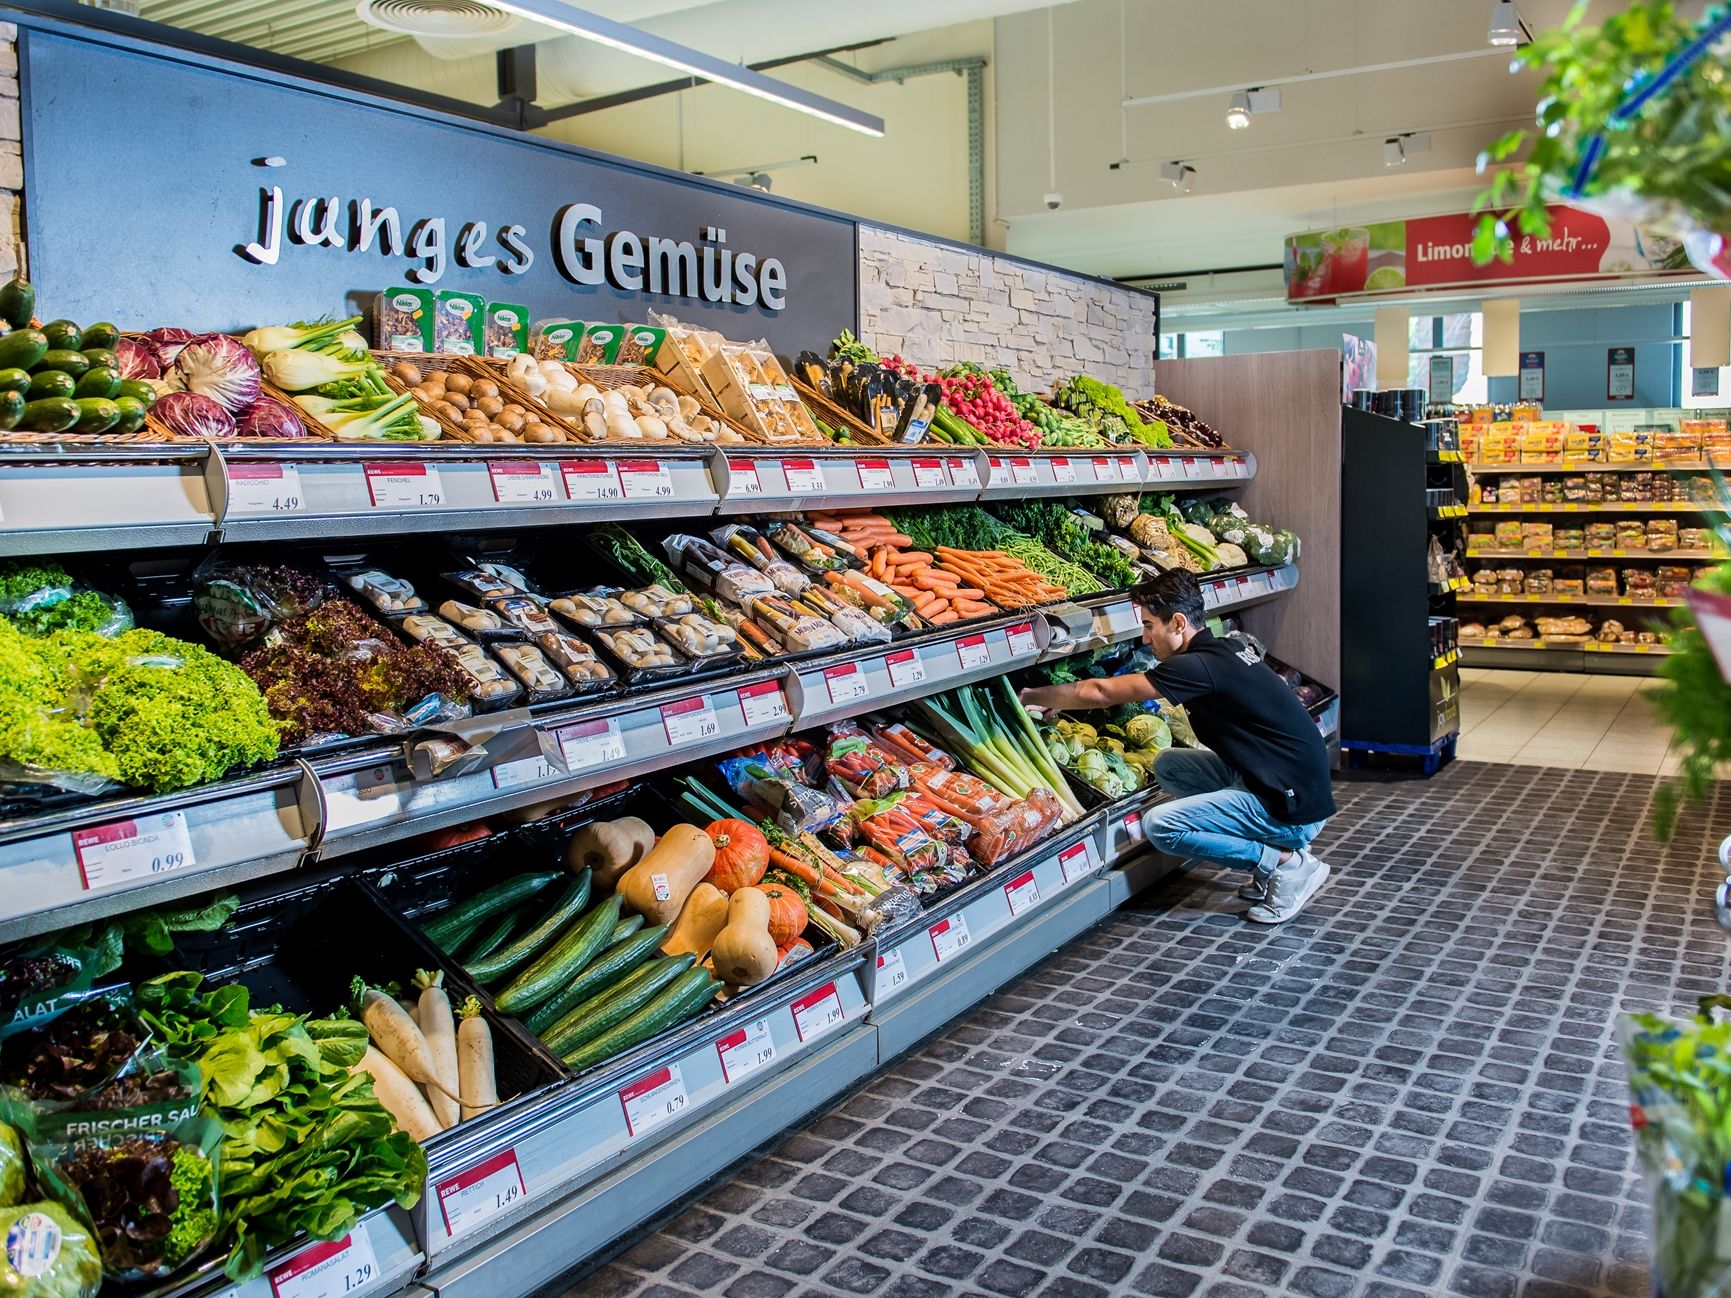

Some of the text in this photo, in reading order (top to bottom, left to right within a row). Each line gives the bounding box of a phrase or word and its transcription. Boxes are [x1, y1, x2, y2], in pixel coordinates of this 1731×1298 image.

[246, 156, 787, 309] junges Gemüse
[1520, 236, 1532, 255] &
[598, 488, 618, 498] 14.90
[656, 486, 671, 496] 4.99
[745, 484, 758, 493] 6.99
[811, 482, 823, 491] 3.33
[419, 494, 440, 505] 1.79
[534, 489, 552, 500] 4.99
[273, 497, 298, 510] 4.49
[700, 723, 715, 736] 1.69
[79, 837, 99, 846] REWE
[105, 835, 159, 851] LOLLO BIONDA
[152, 852, 183, 872] 0.99
[12, 998, 58, 1023] ALAT
[828, 1008, 840, 1023] 1.99
[758, 1048, 772, 1064] 1.99
[623, 1091, 635, 1101] REWE
[667, 1095, 684, 1113] 0.79
[66, 1114, 163, 1136] FRISCHER
[441, 1183, 460, 1198] REWE
[461, 1181, 484, 1197] RETTICH
[496, 1185, 517, 1208] 1.49
[302, 1250, 350, 1281] ROMANASALAT
[274, 1269, 293, 1284] REWE
[344, 1264, 371, 1291] 1.29
